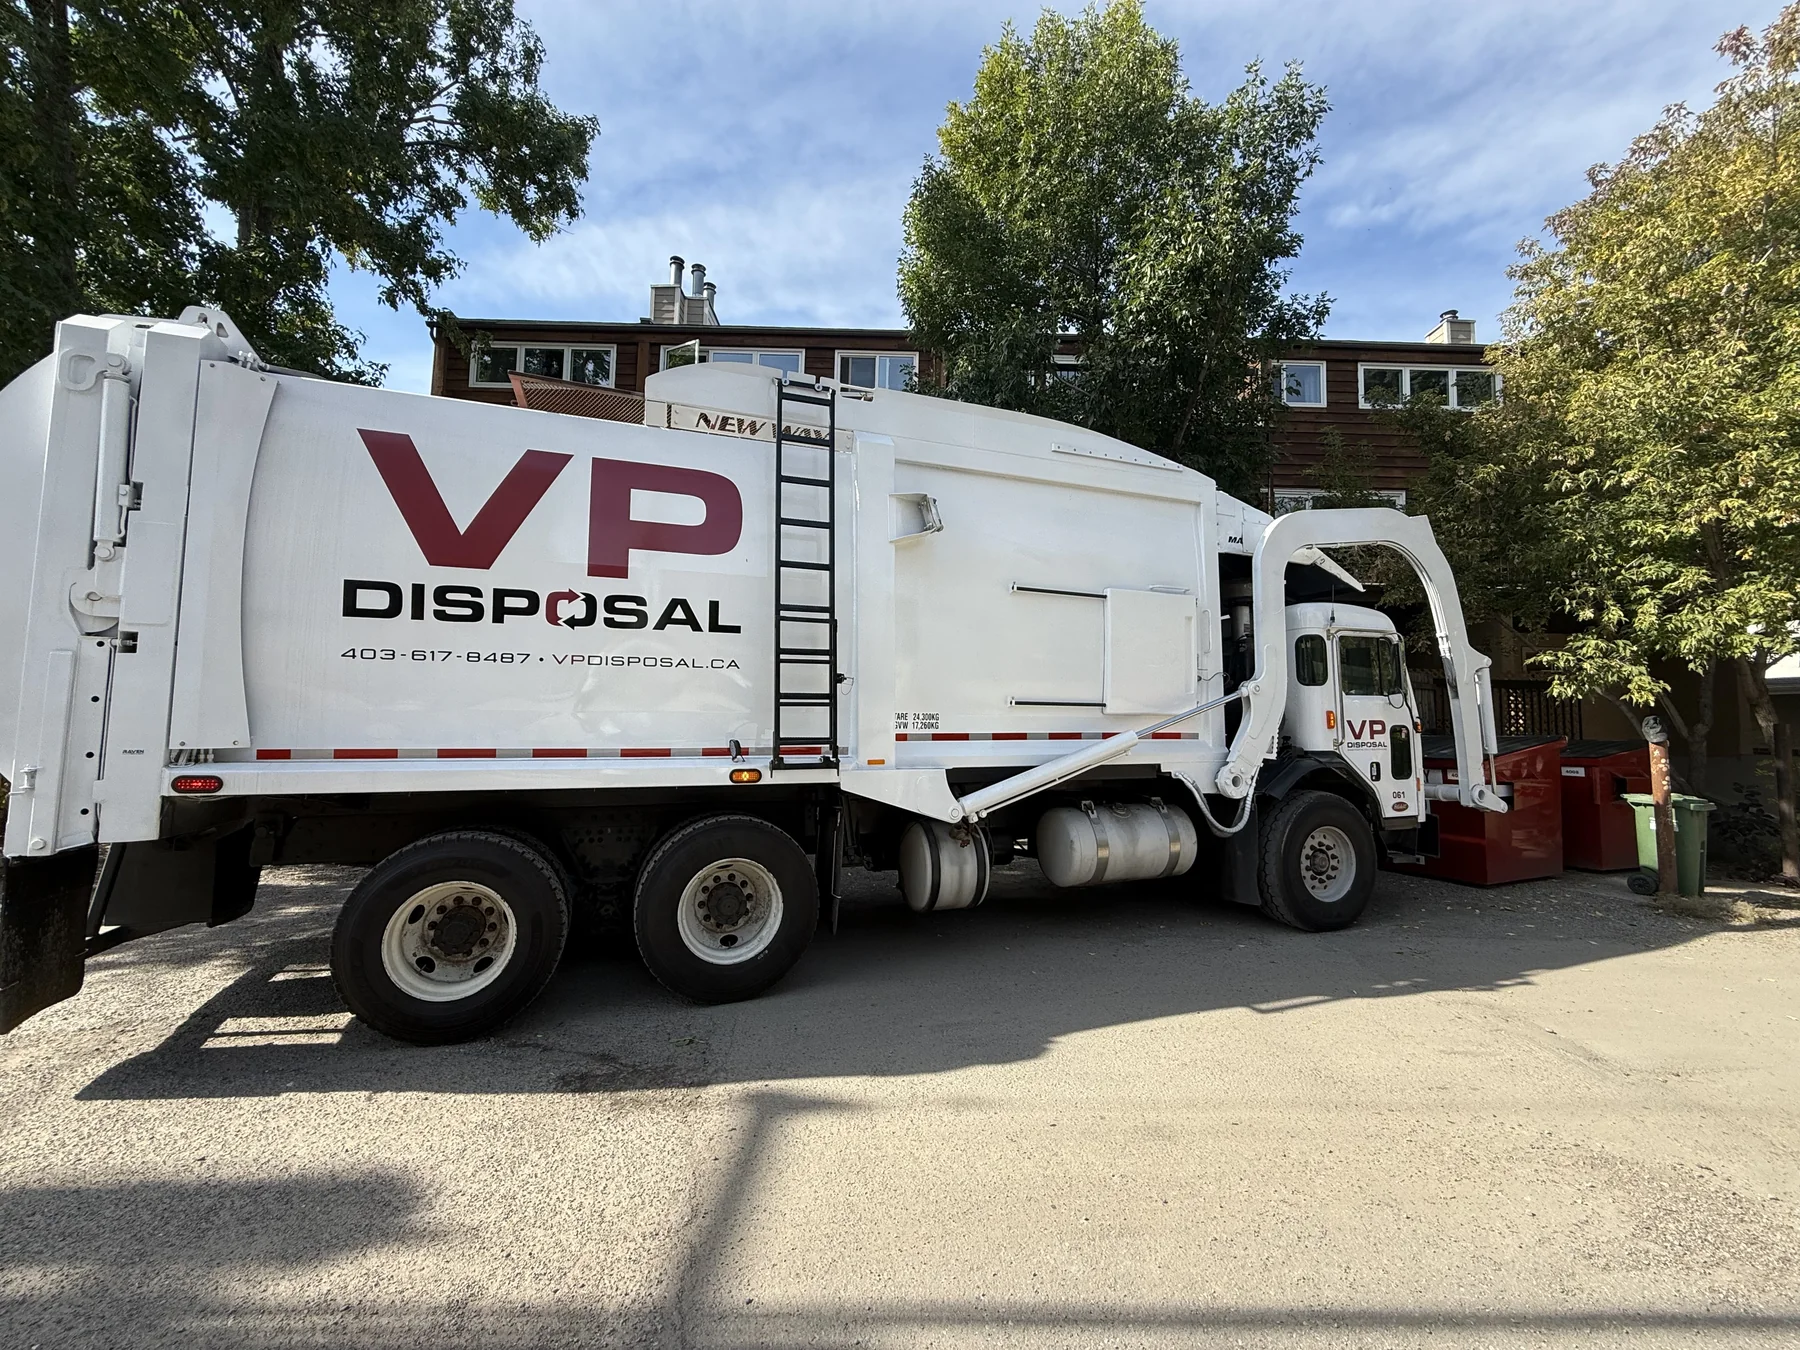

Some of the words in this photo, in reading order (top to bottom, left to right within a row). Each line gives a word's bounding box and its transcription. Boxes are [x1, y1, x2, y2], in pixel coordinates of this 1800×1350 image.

[695, 412, 767, 436] NEW
[356, 427, 743, 579] VP
[342, 578, 742, 634] DISPOSAL
[340, 647, 531, 664] 403-617-8487
[552, 653, 741, 670] VPDISPOSAL.CA
[1346, 719, 1387, 740] VP
[1346, 741, 1388, 749] DISPOSAL
[1392, 790, 1406, 799] 061
